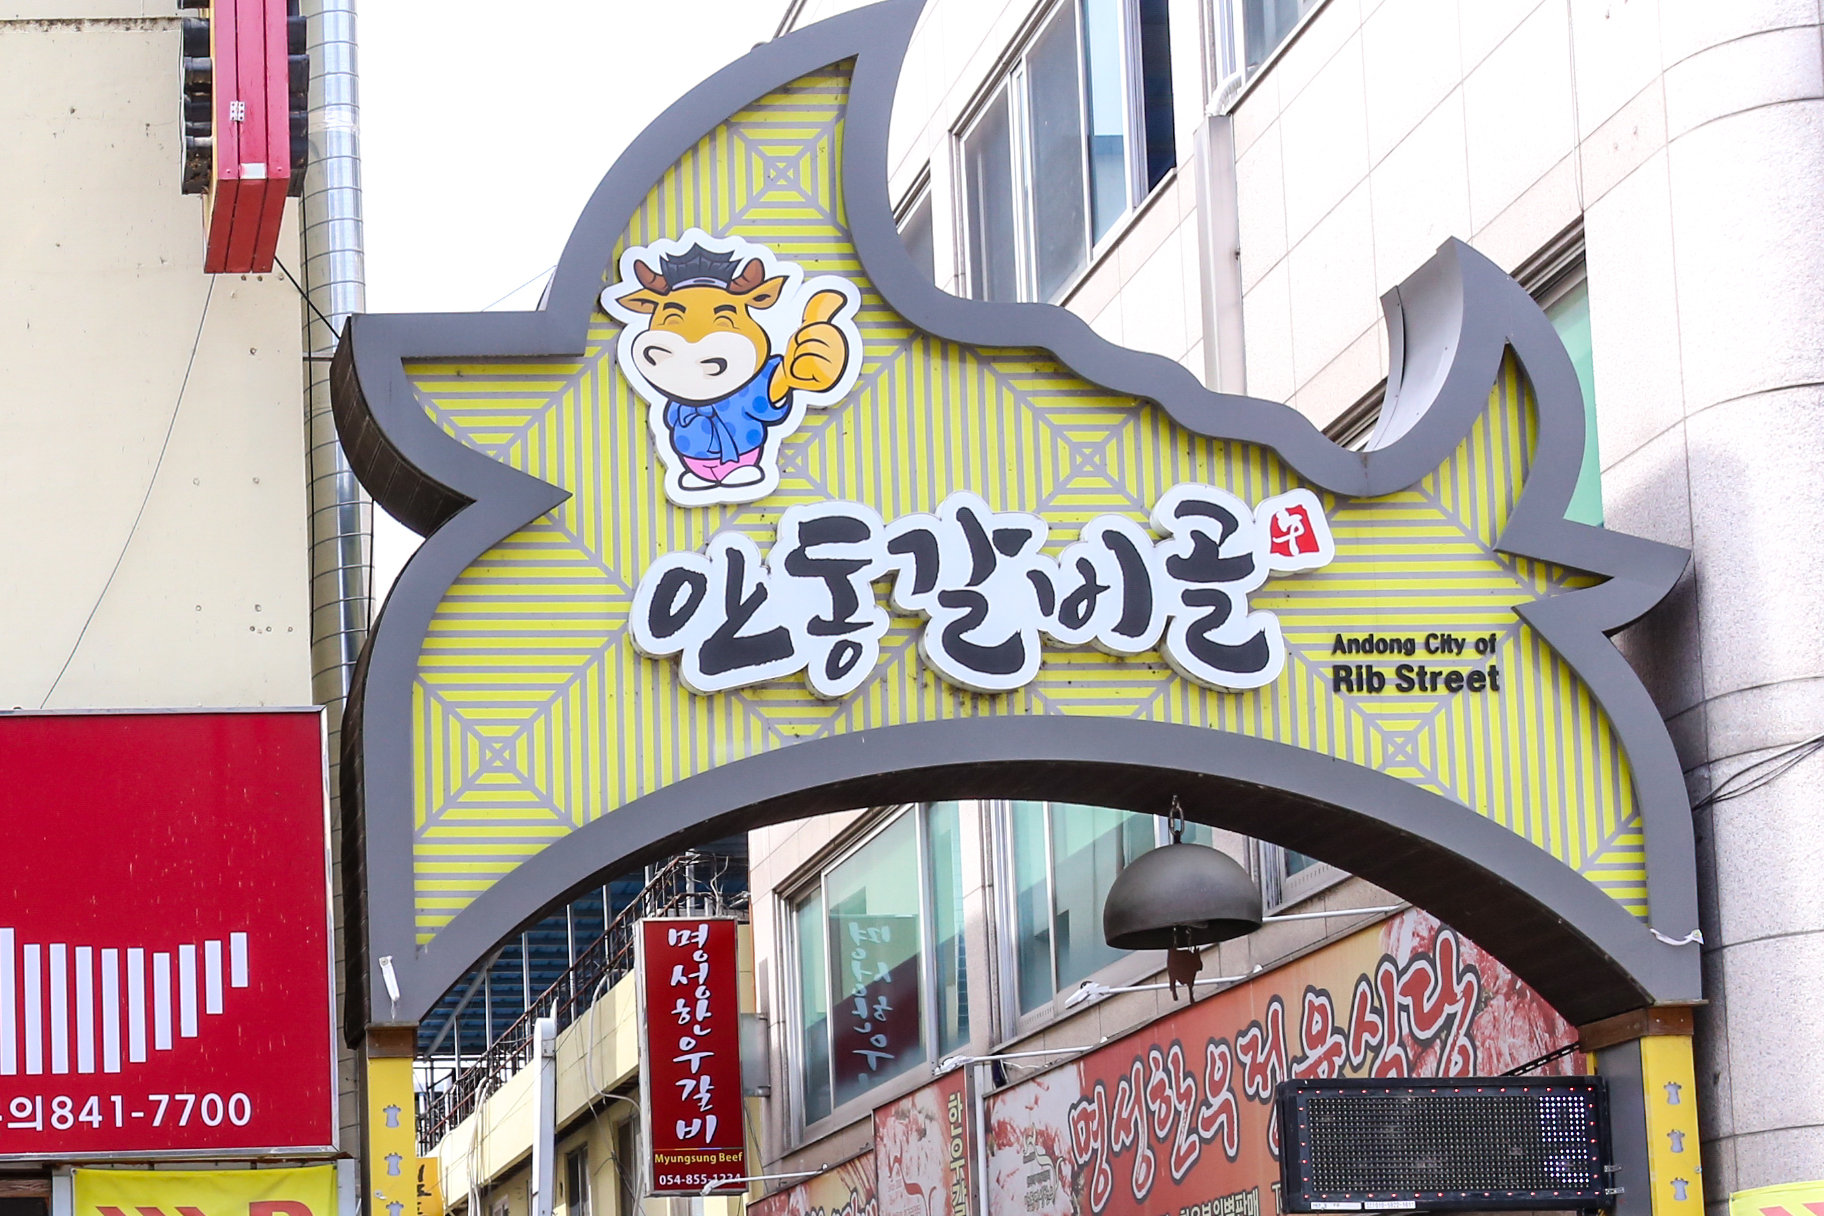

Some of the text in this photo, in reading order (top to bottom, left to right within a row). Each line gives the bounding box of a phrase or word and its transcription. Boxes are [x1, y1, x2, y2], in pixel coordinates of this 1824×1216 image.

[648, 498, 1271, 681] 안동갈비골
[1331, 632, 1497, 656] Andong City of
[1332, 663, 1500, 693] Rib Street
[668, 923, 718, 1144] 명성한우갈비
[654, 1151, 743, 1166] Myungsung Beef
